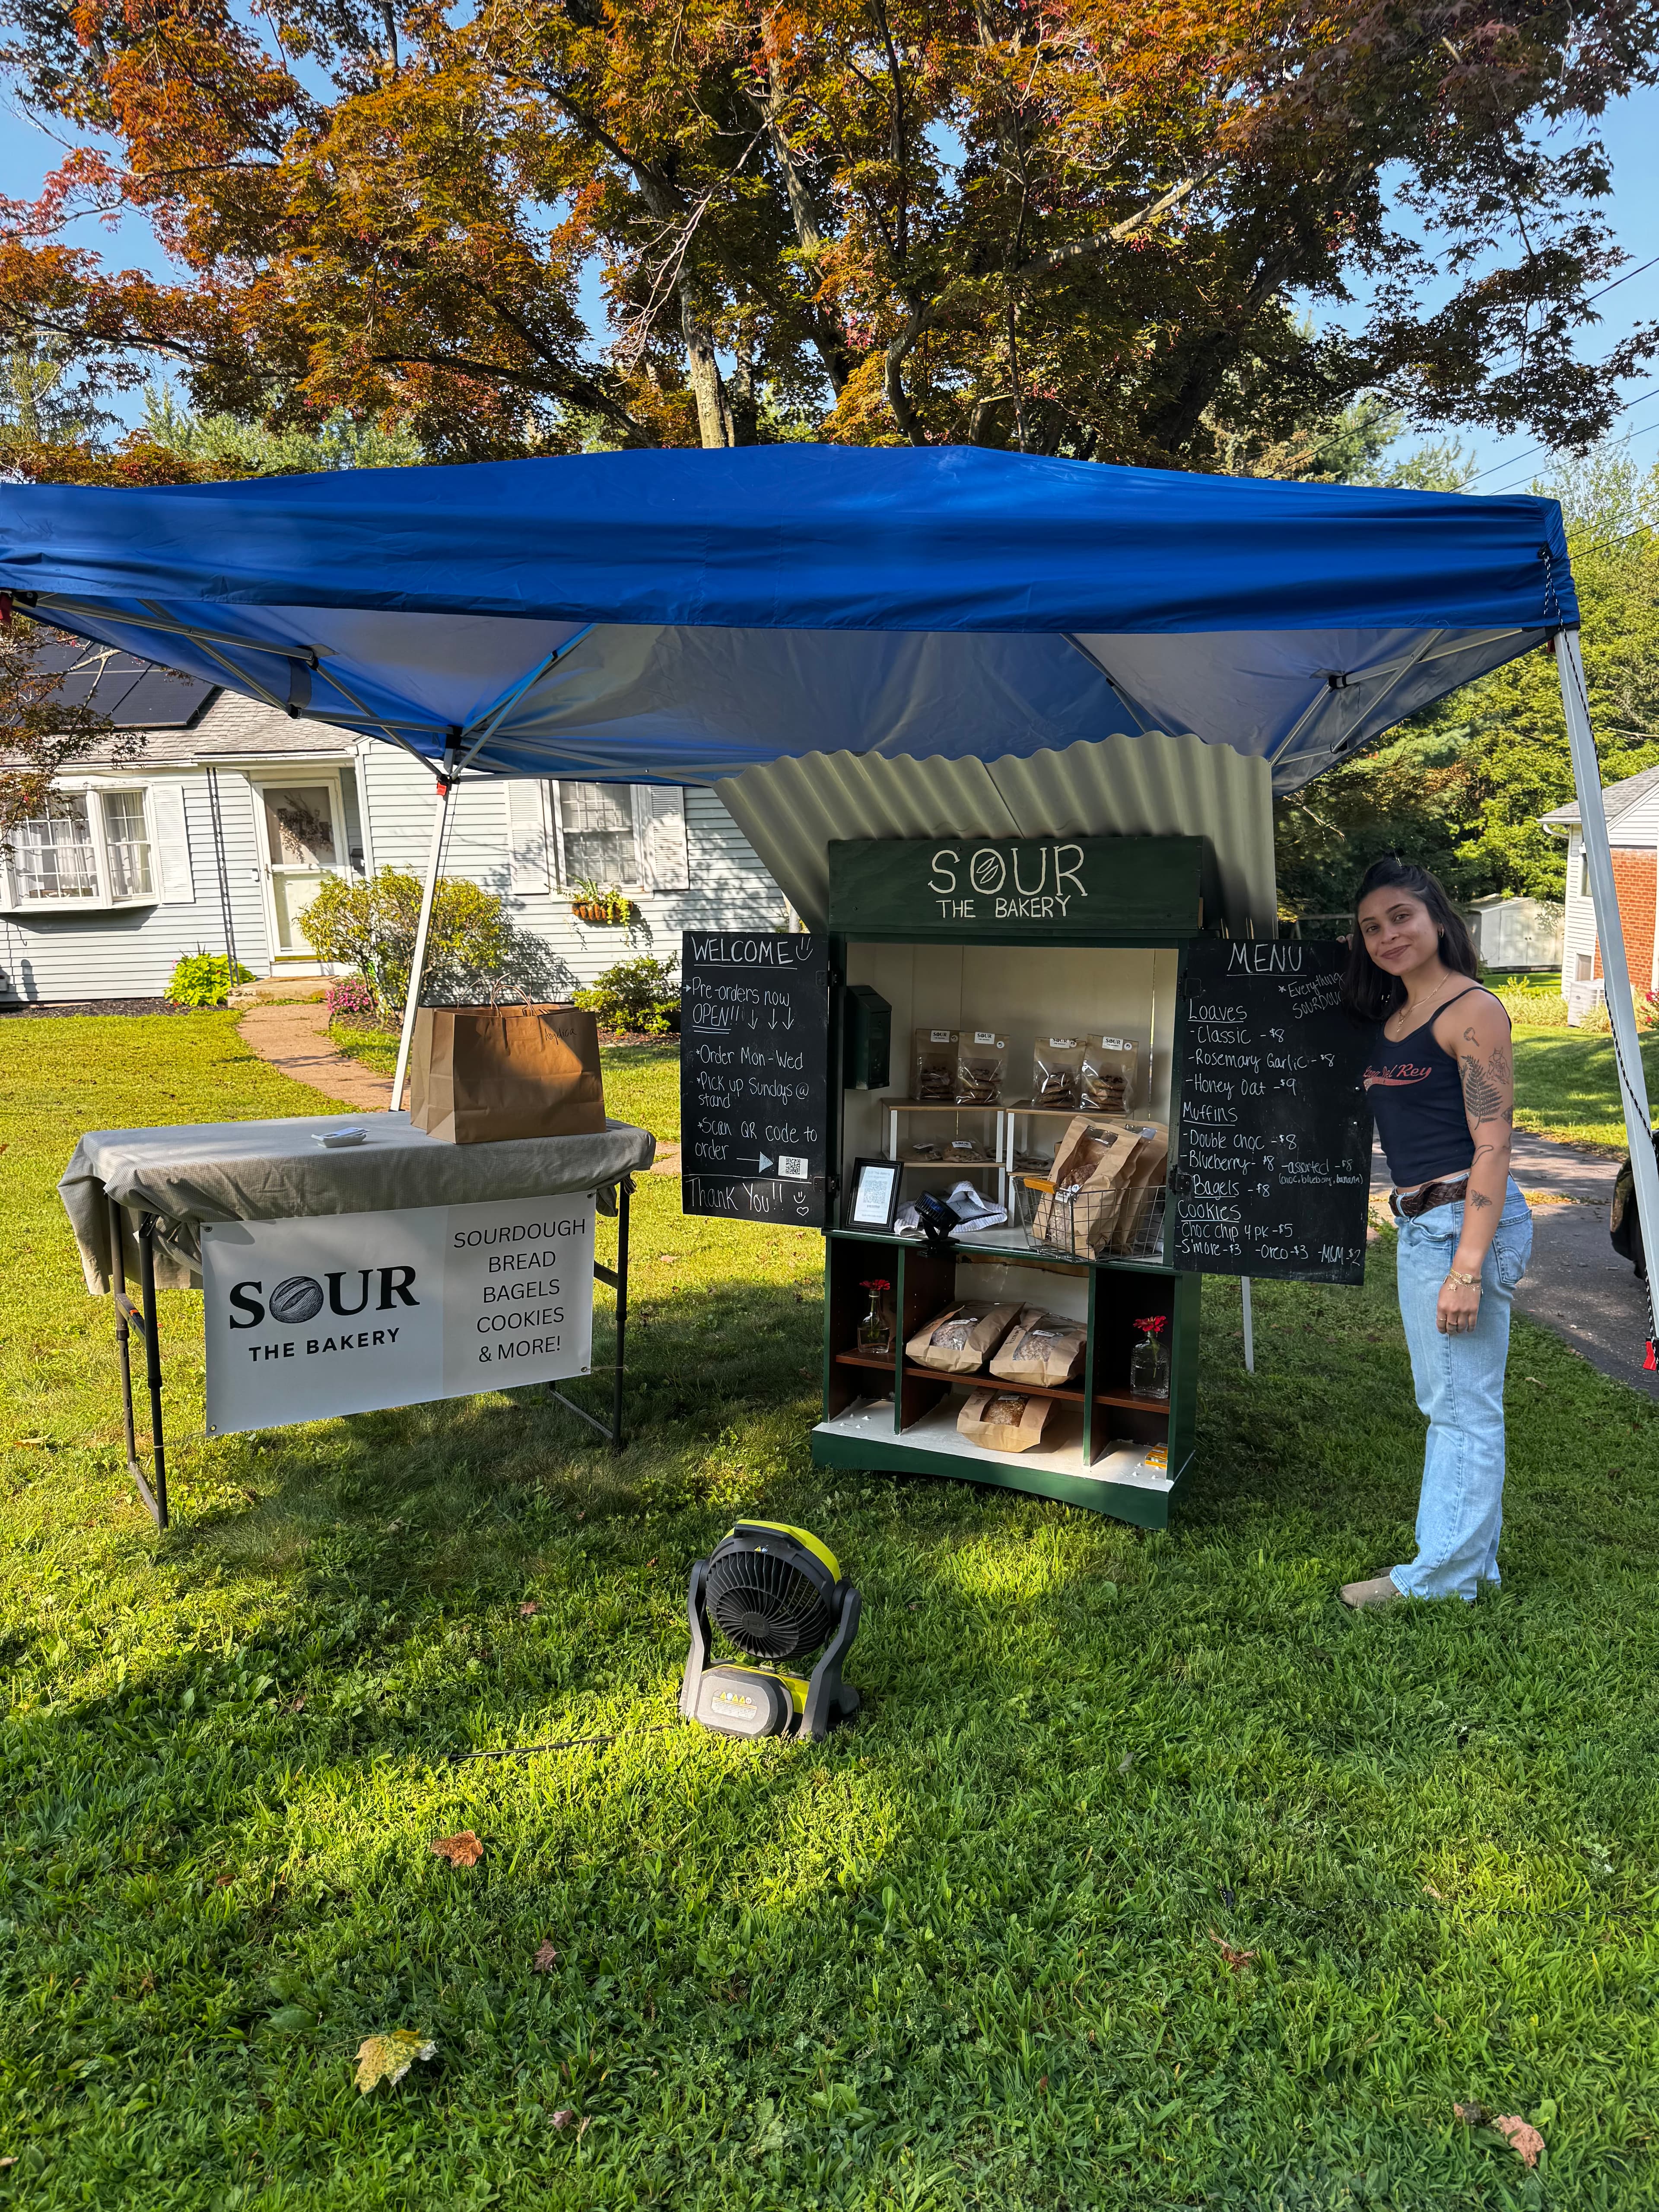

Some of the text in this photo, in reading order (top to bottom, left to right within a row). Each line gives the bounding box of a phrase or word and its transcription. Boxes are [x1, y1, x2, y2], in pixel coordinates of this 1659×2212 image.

[928, 844, 1088, 897] SOUR
[936, 895, 1071, 919] THE BAKERY
[691, 936, 794, 965] WELCOME
[1227, 942, 1302, 973] MENU
[693, 976, 790, 1007] Pre-orders now
[693, 1003, 740, 1027] OPEN!!
[1189, 998, 1247, 1020] Loaves
[1267, 1053, 1307, 1071] Garlic
[1396, 1063, 1432, 1079] Rey
[729, 1078, 744, 1097] up
[748, 1077, 793, 1106] Sundays
[795, 1082, 809, 1100] @
[1241, 1078, 1266, 1095] Oat
[698, 1093, 731, 1109] stand
[1182, 1101, 1238, 1122] Muffins
[741, 1121, 757, 1140] QR
[765, 1122, 799, 1143] code
[803, 1126, 817, 1142] to
[695, 1139, 729, 1160] order
[685, 1176, 784, 1213] Thank You!!
[1192, 1174, 1239, 1201] Bagels
[453, 1218, 586, 1249] SOURDOUGH
[1244, 1224, 1251, 1240] 4
[488, 1251, 556, 1274] BREAD
[229, 1265, 420, 1330] SOUR
[483, 1279, 561, 1304] BAGELS
[476, 1307, 565, 1334] COOKIES
[248, 1327, 401, 1363] THE BAKERY
[478, 1335, 561, 1363] & MORE!
